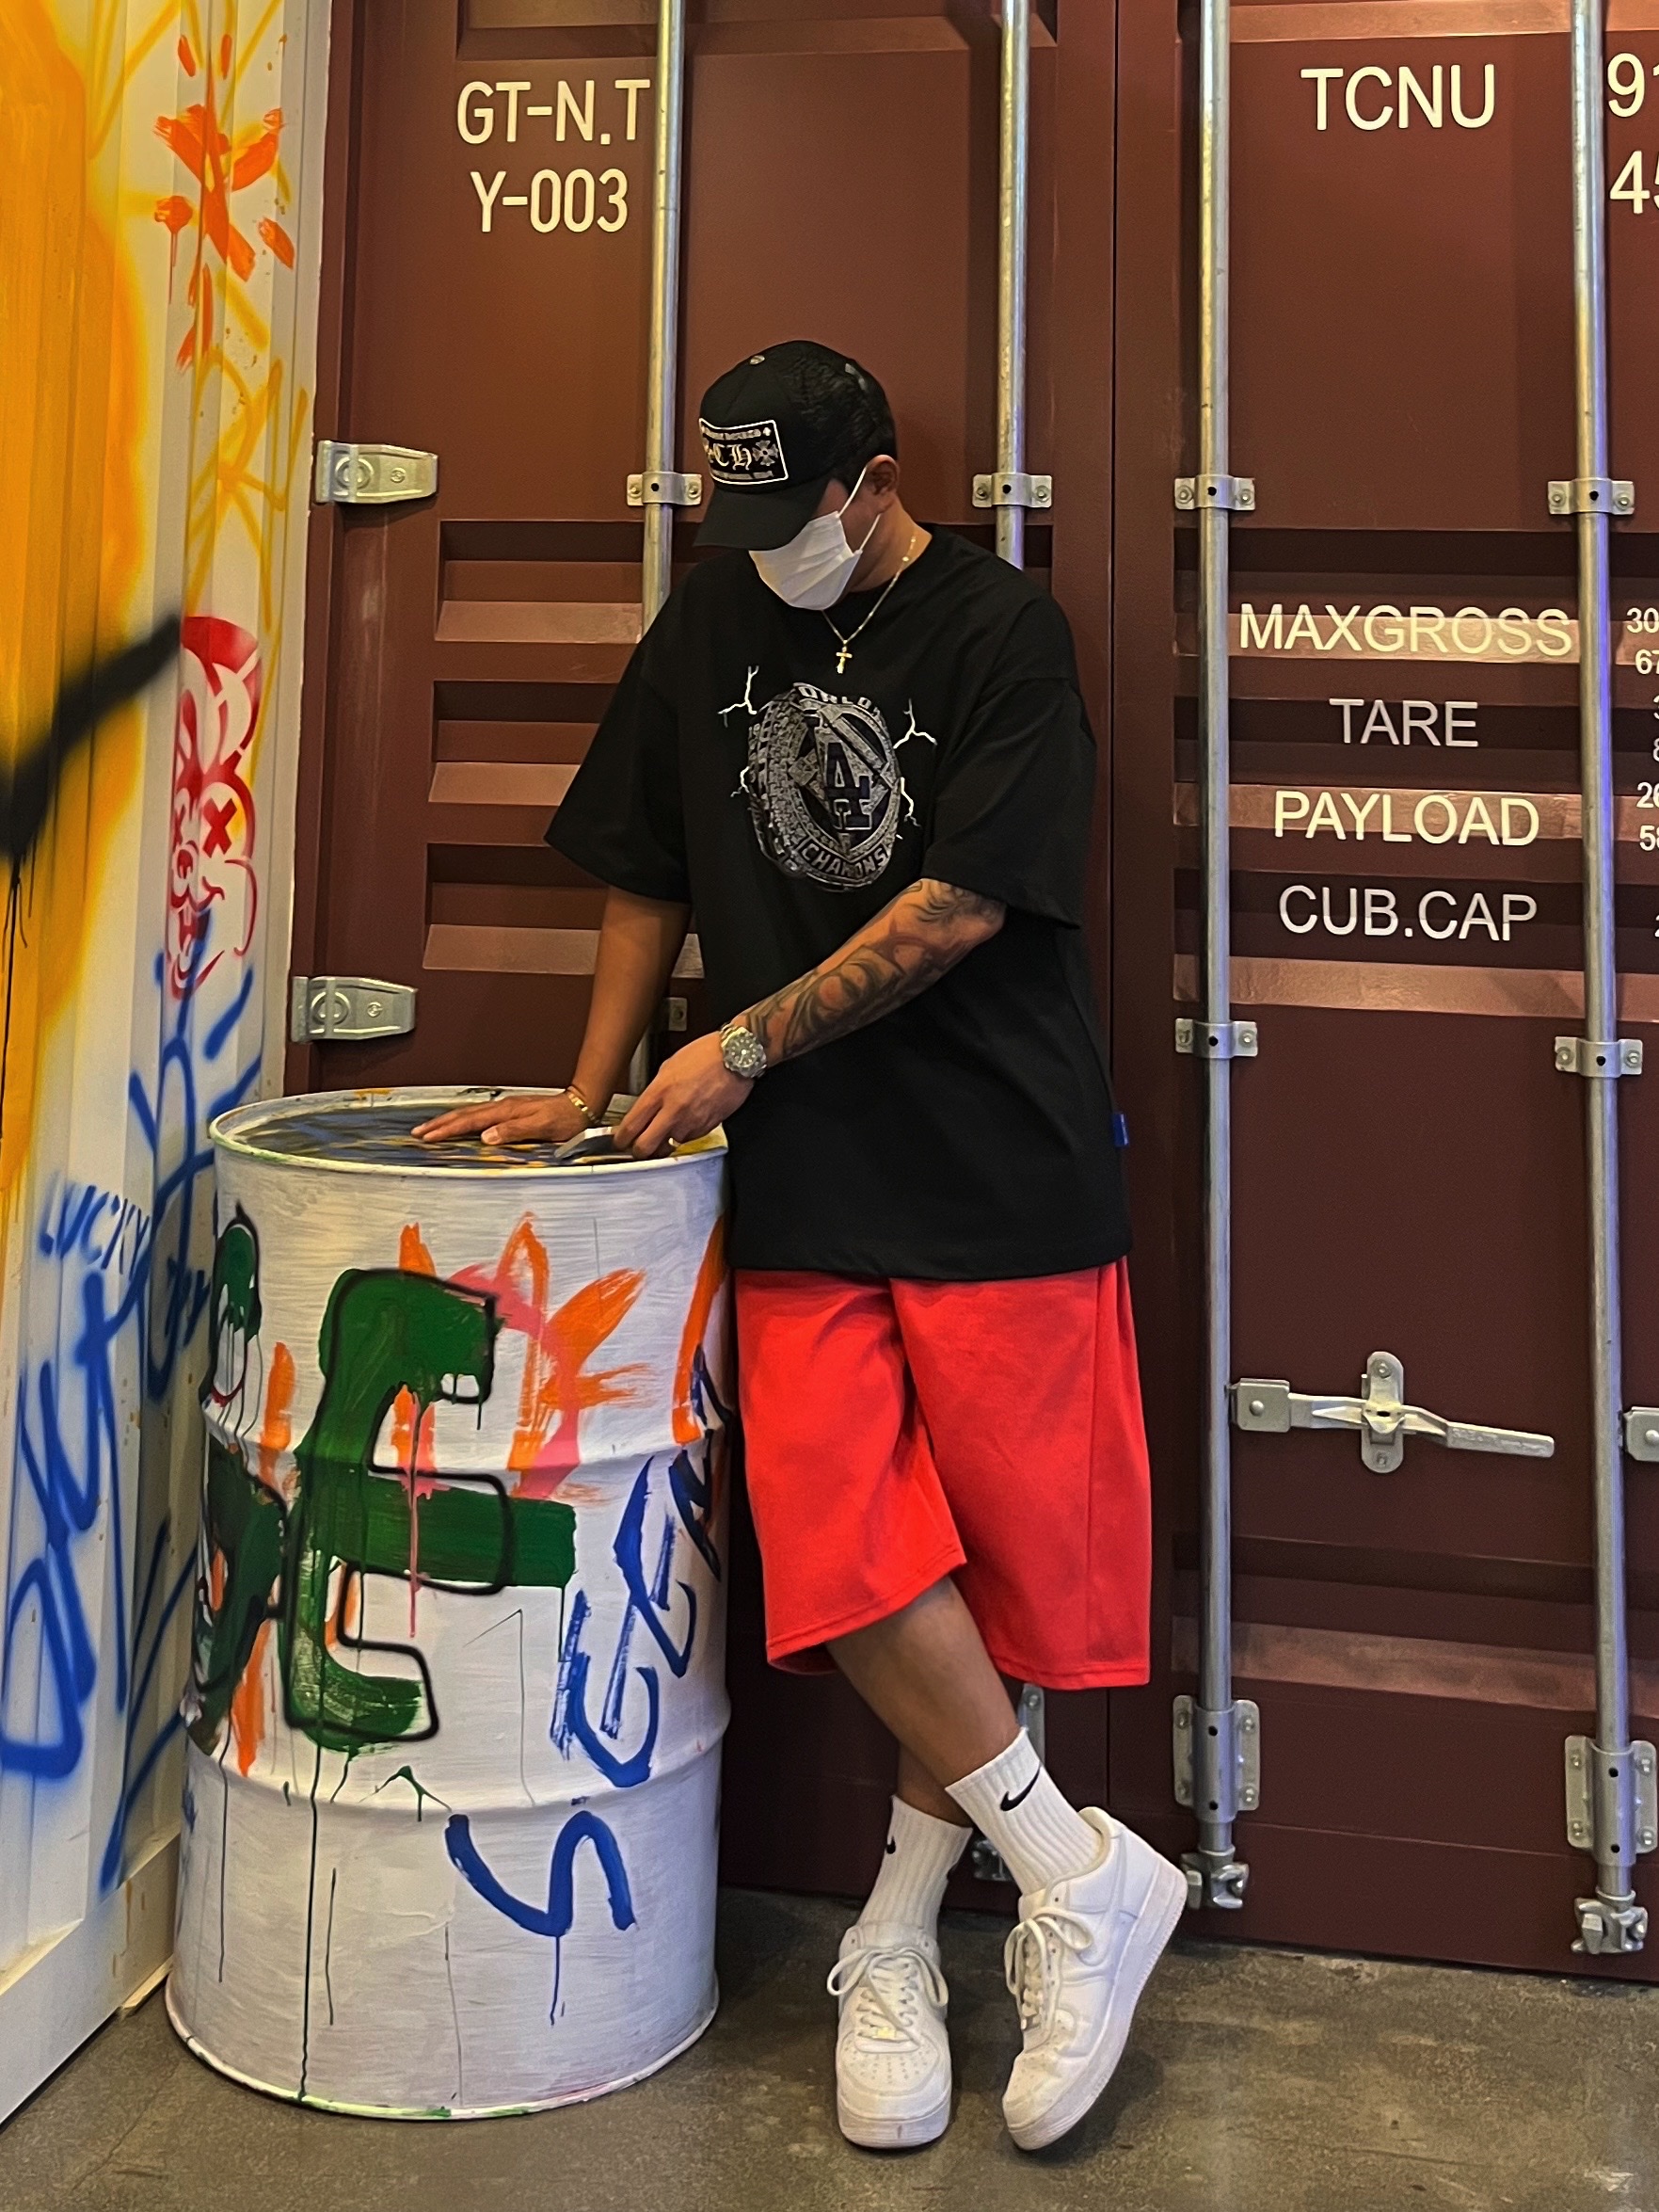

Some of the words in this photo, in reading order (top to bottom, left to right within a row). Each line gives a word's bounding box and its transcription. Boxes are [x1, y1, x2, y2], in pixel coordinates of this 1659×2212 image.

[456, 78, 651, 145] GT-N.T
[1300, 64, 1496, 130] TCNU
[1606, 52, 1659, 118] 9
[470, 168, 629, 233] Y-003
[1609, 150, 1659, 215] 4
[1239, 603, 1572, 656] MAXGROSS
[1329, 697, 1479, 747] TARE
[1273, 790, 1540, 847] PAYLOAD
[1639, 825, 1659, 851] 5
[1279, 885, 1538, 942] CUB.CAP
